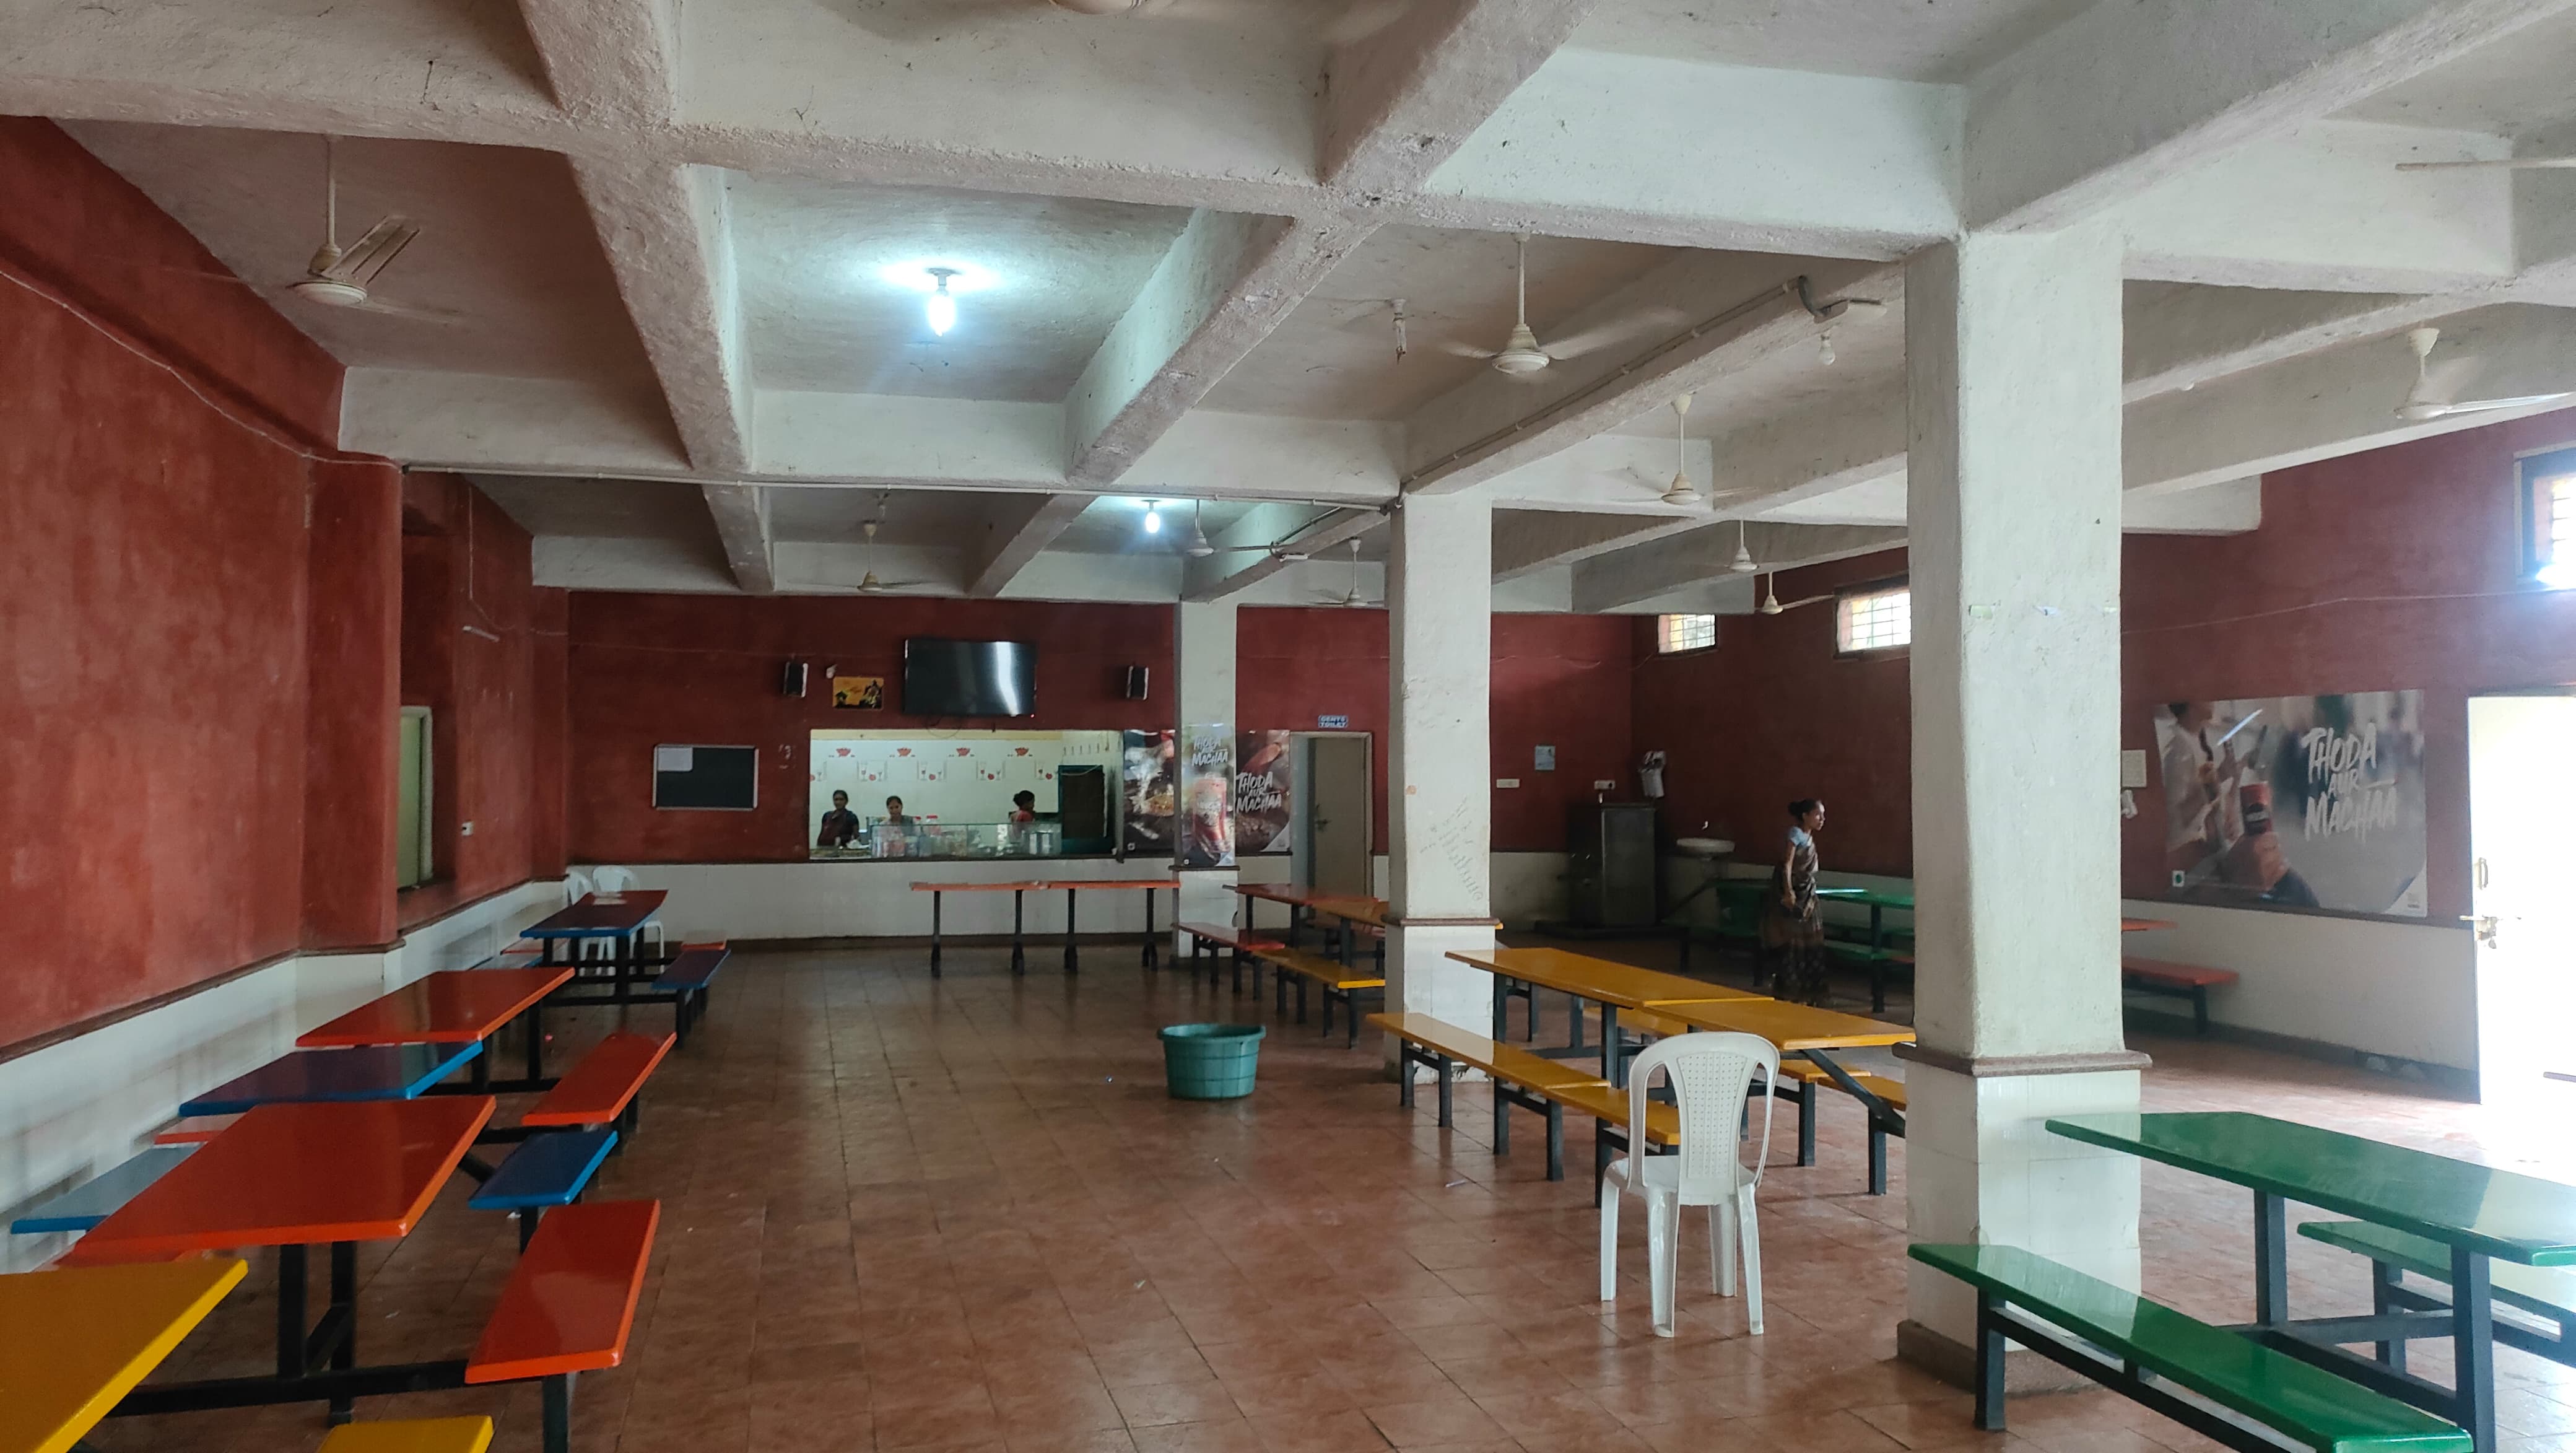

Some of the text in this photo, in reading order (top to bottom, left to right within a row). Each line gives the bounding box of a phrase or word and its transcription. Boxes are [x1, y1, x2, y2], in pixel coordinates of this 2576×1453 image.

[2300, 723, 2377, 785] THODA
[1236, 771, 1273, 794] THODA
[1236, 794, 1282, 813] MACHAA
[2304, 786, 2397, 843] MACHAA
